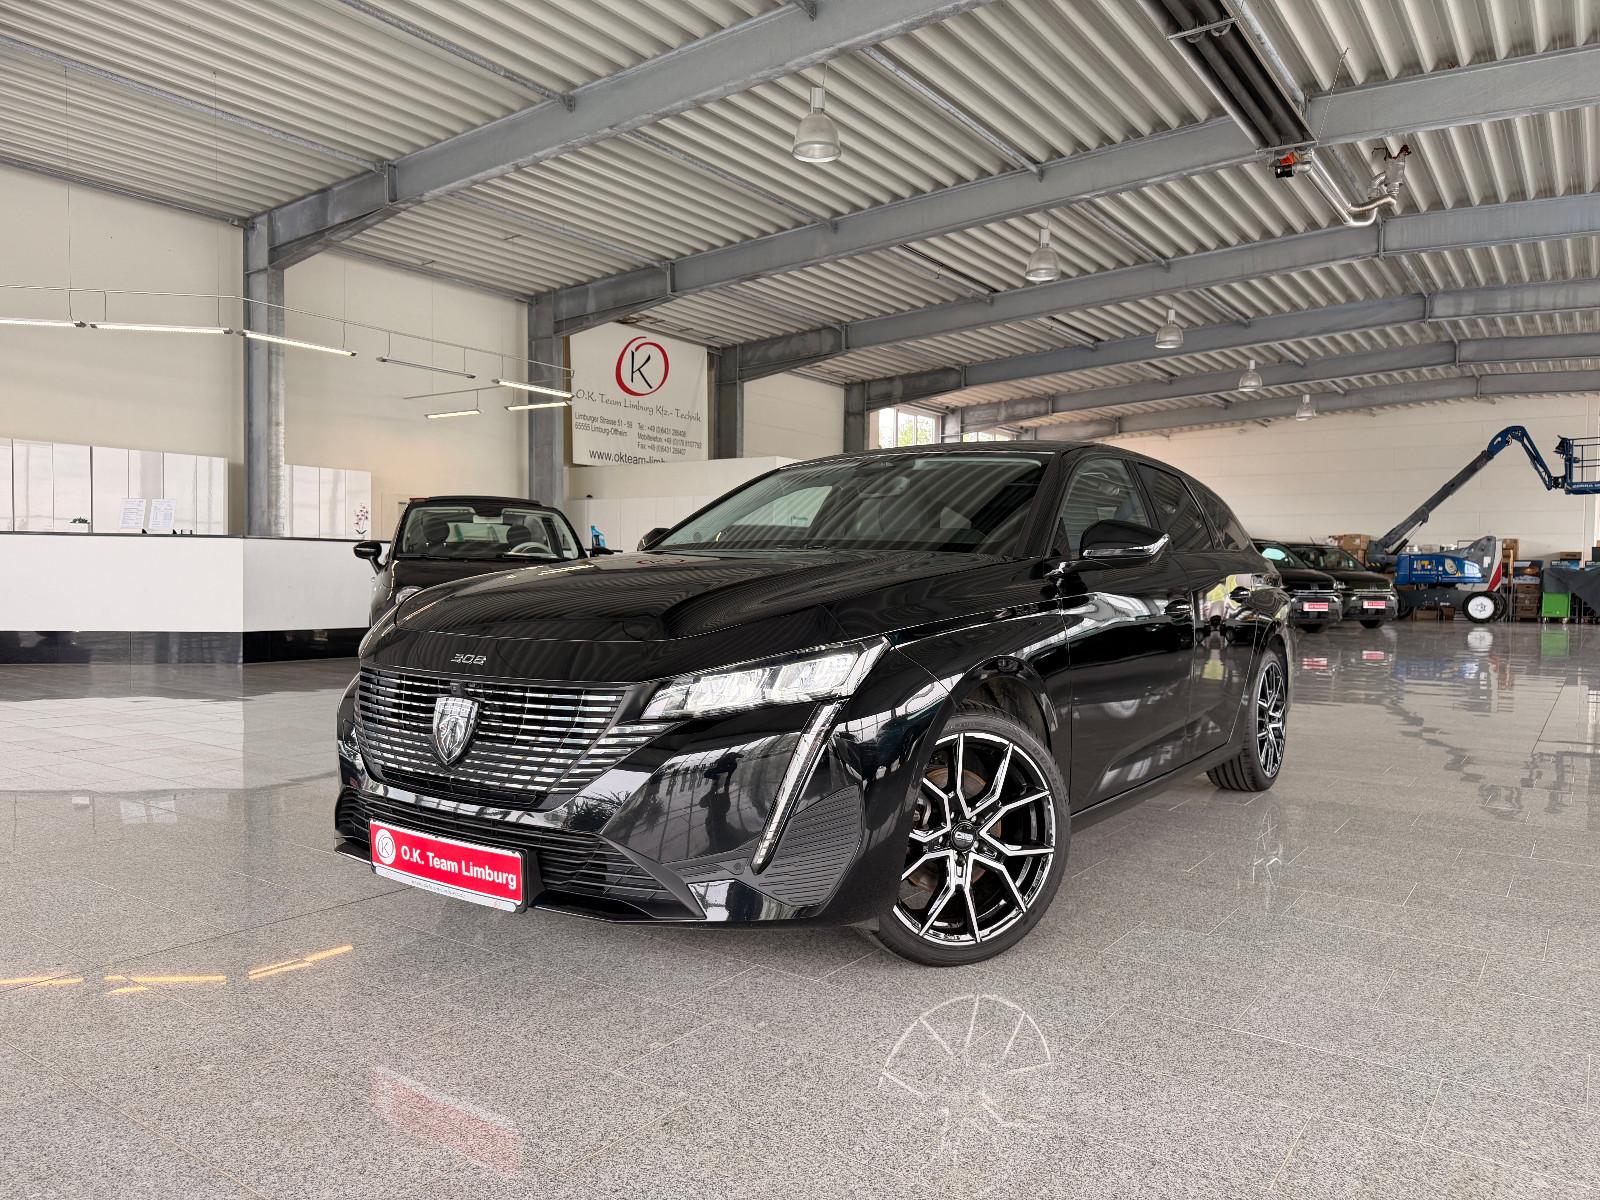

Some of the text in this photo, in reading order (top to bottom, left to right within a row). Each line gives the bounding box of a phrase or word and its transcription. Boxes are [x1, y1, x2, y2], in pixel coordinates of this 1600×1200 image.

[575, 388, 597, 402] O.K.
[598, 392, 622, 407] Team
[623, 398, 654, 416] Limburg
[674, 408, 702, 423] Technik
[574, 411, 599, 424] Limburger
[599, 415, 617, 426] Strasse
[450, 653, 487, 666] 308
[400, 845, 424, 865] O.K.
[426, 851, 459, 874] Team
[461, 859, 518, 890] Limburg
